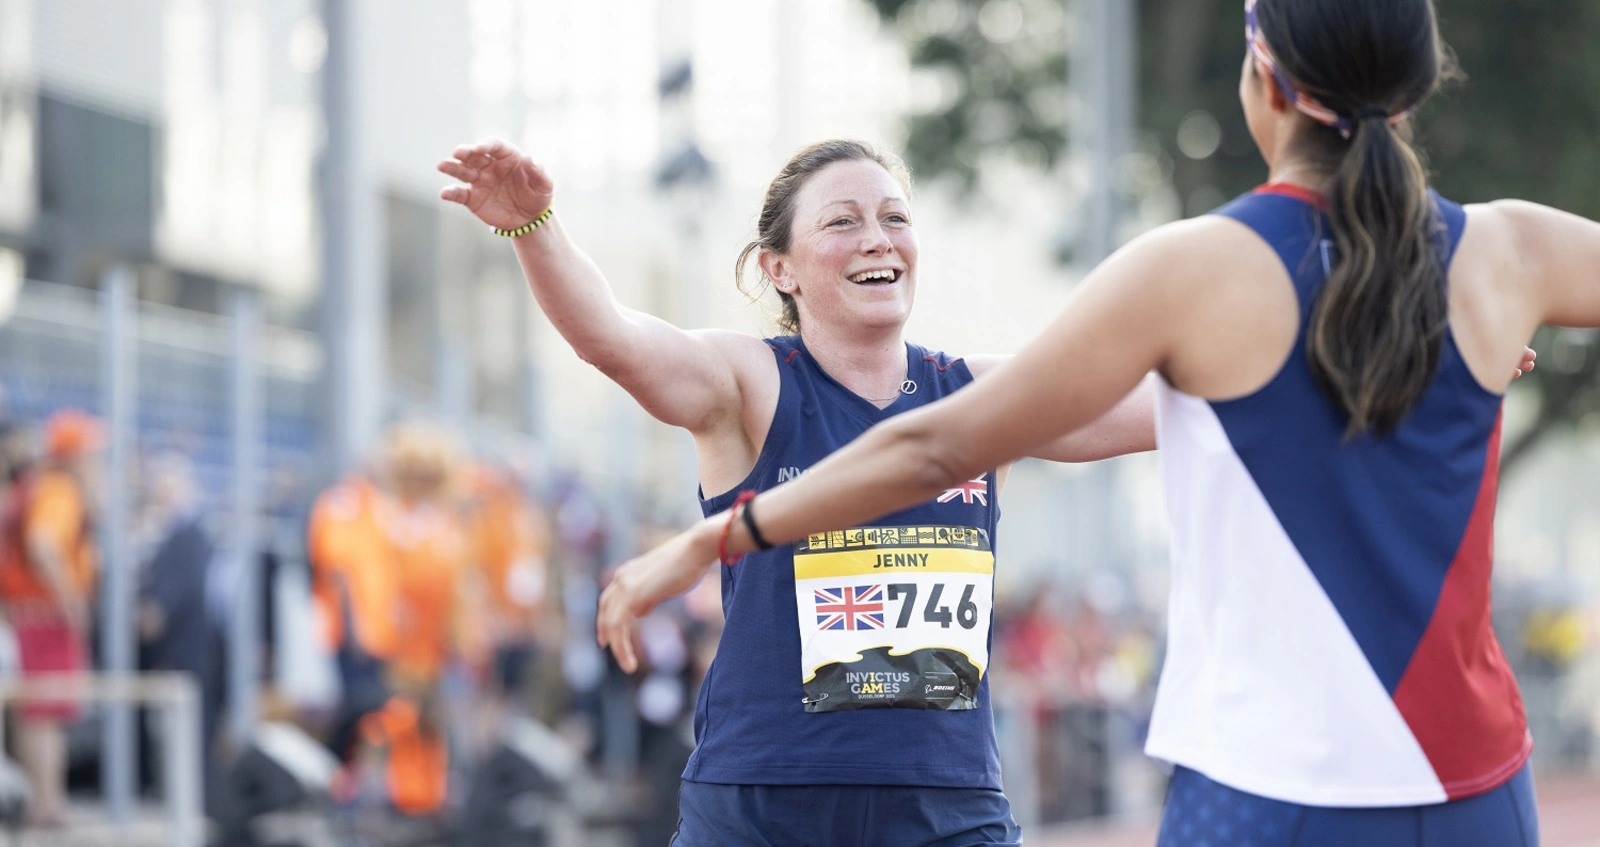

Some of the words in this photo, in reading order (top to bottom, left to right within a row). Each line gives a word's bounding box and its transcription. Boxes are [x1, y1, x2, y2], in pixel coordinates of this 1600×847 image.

[873, 553, 929, 568] JENNY
[887, 583, 978, 630] 746
[846, 672, 911, 683] INVICTUS
[850, 682, 901, 694] GAMES
